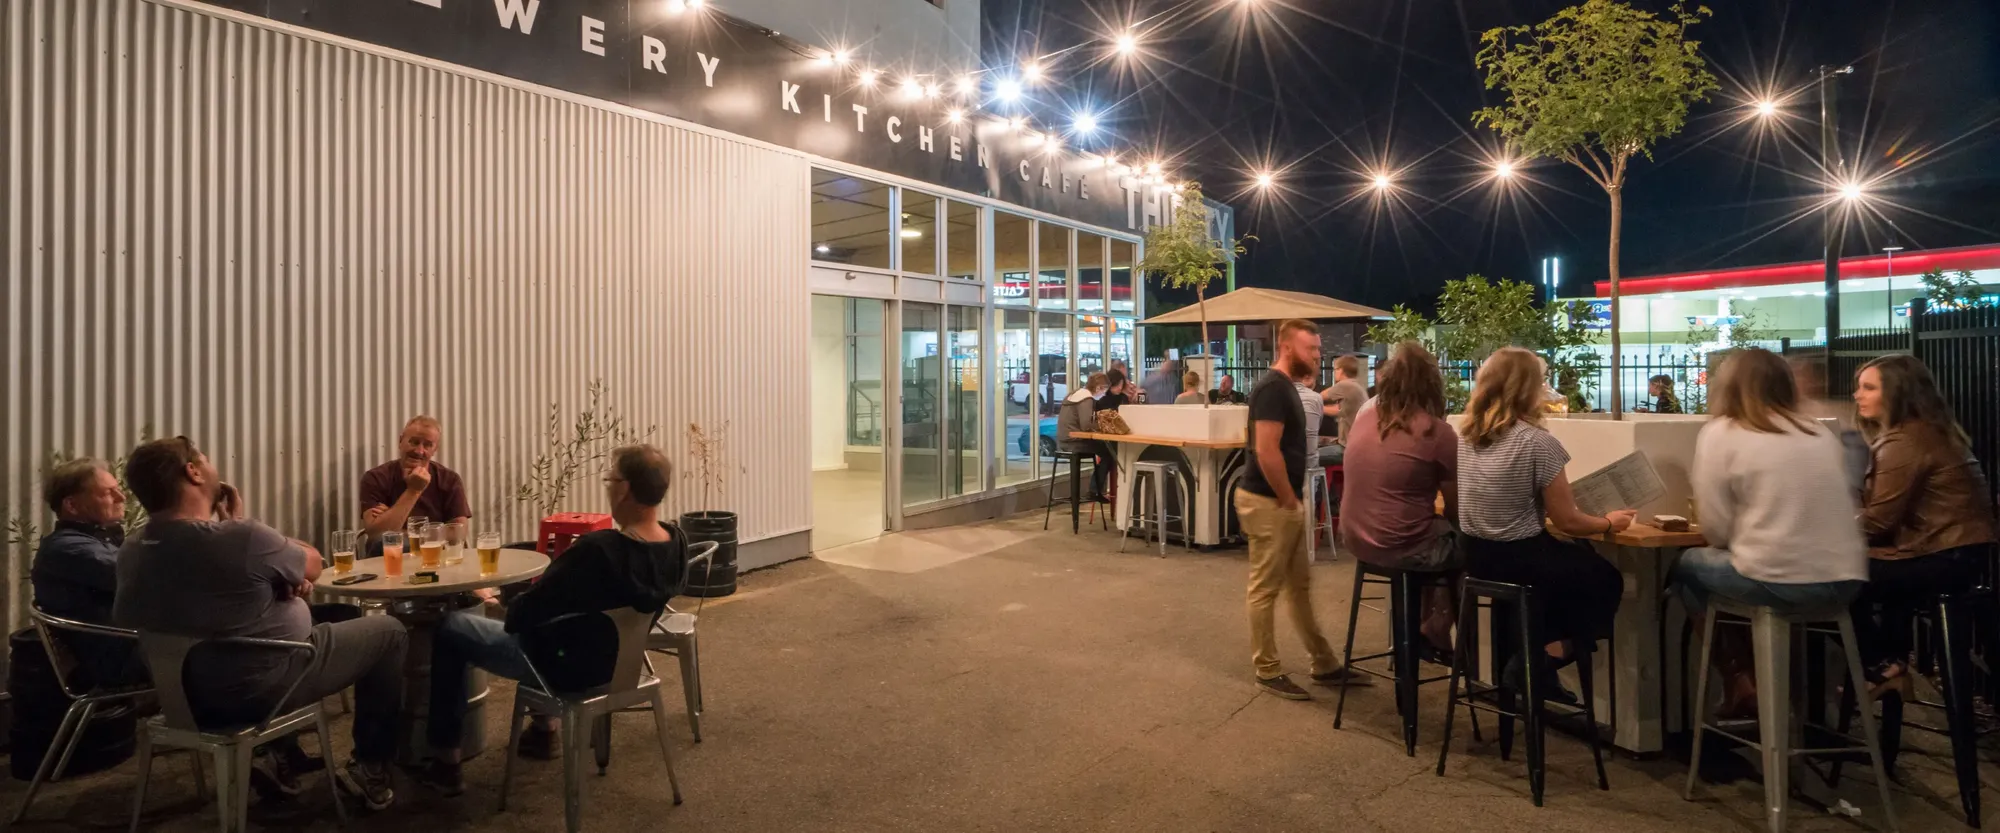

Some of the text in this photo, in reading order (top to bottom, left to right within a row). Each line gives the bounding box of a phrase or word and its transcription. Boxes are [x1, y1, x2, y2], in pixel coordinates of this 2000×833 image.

[411, 0, 1089, 200] WERY KITCHEN CAFÉ
